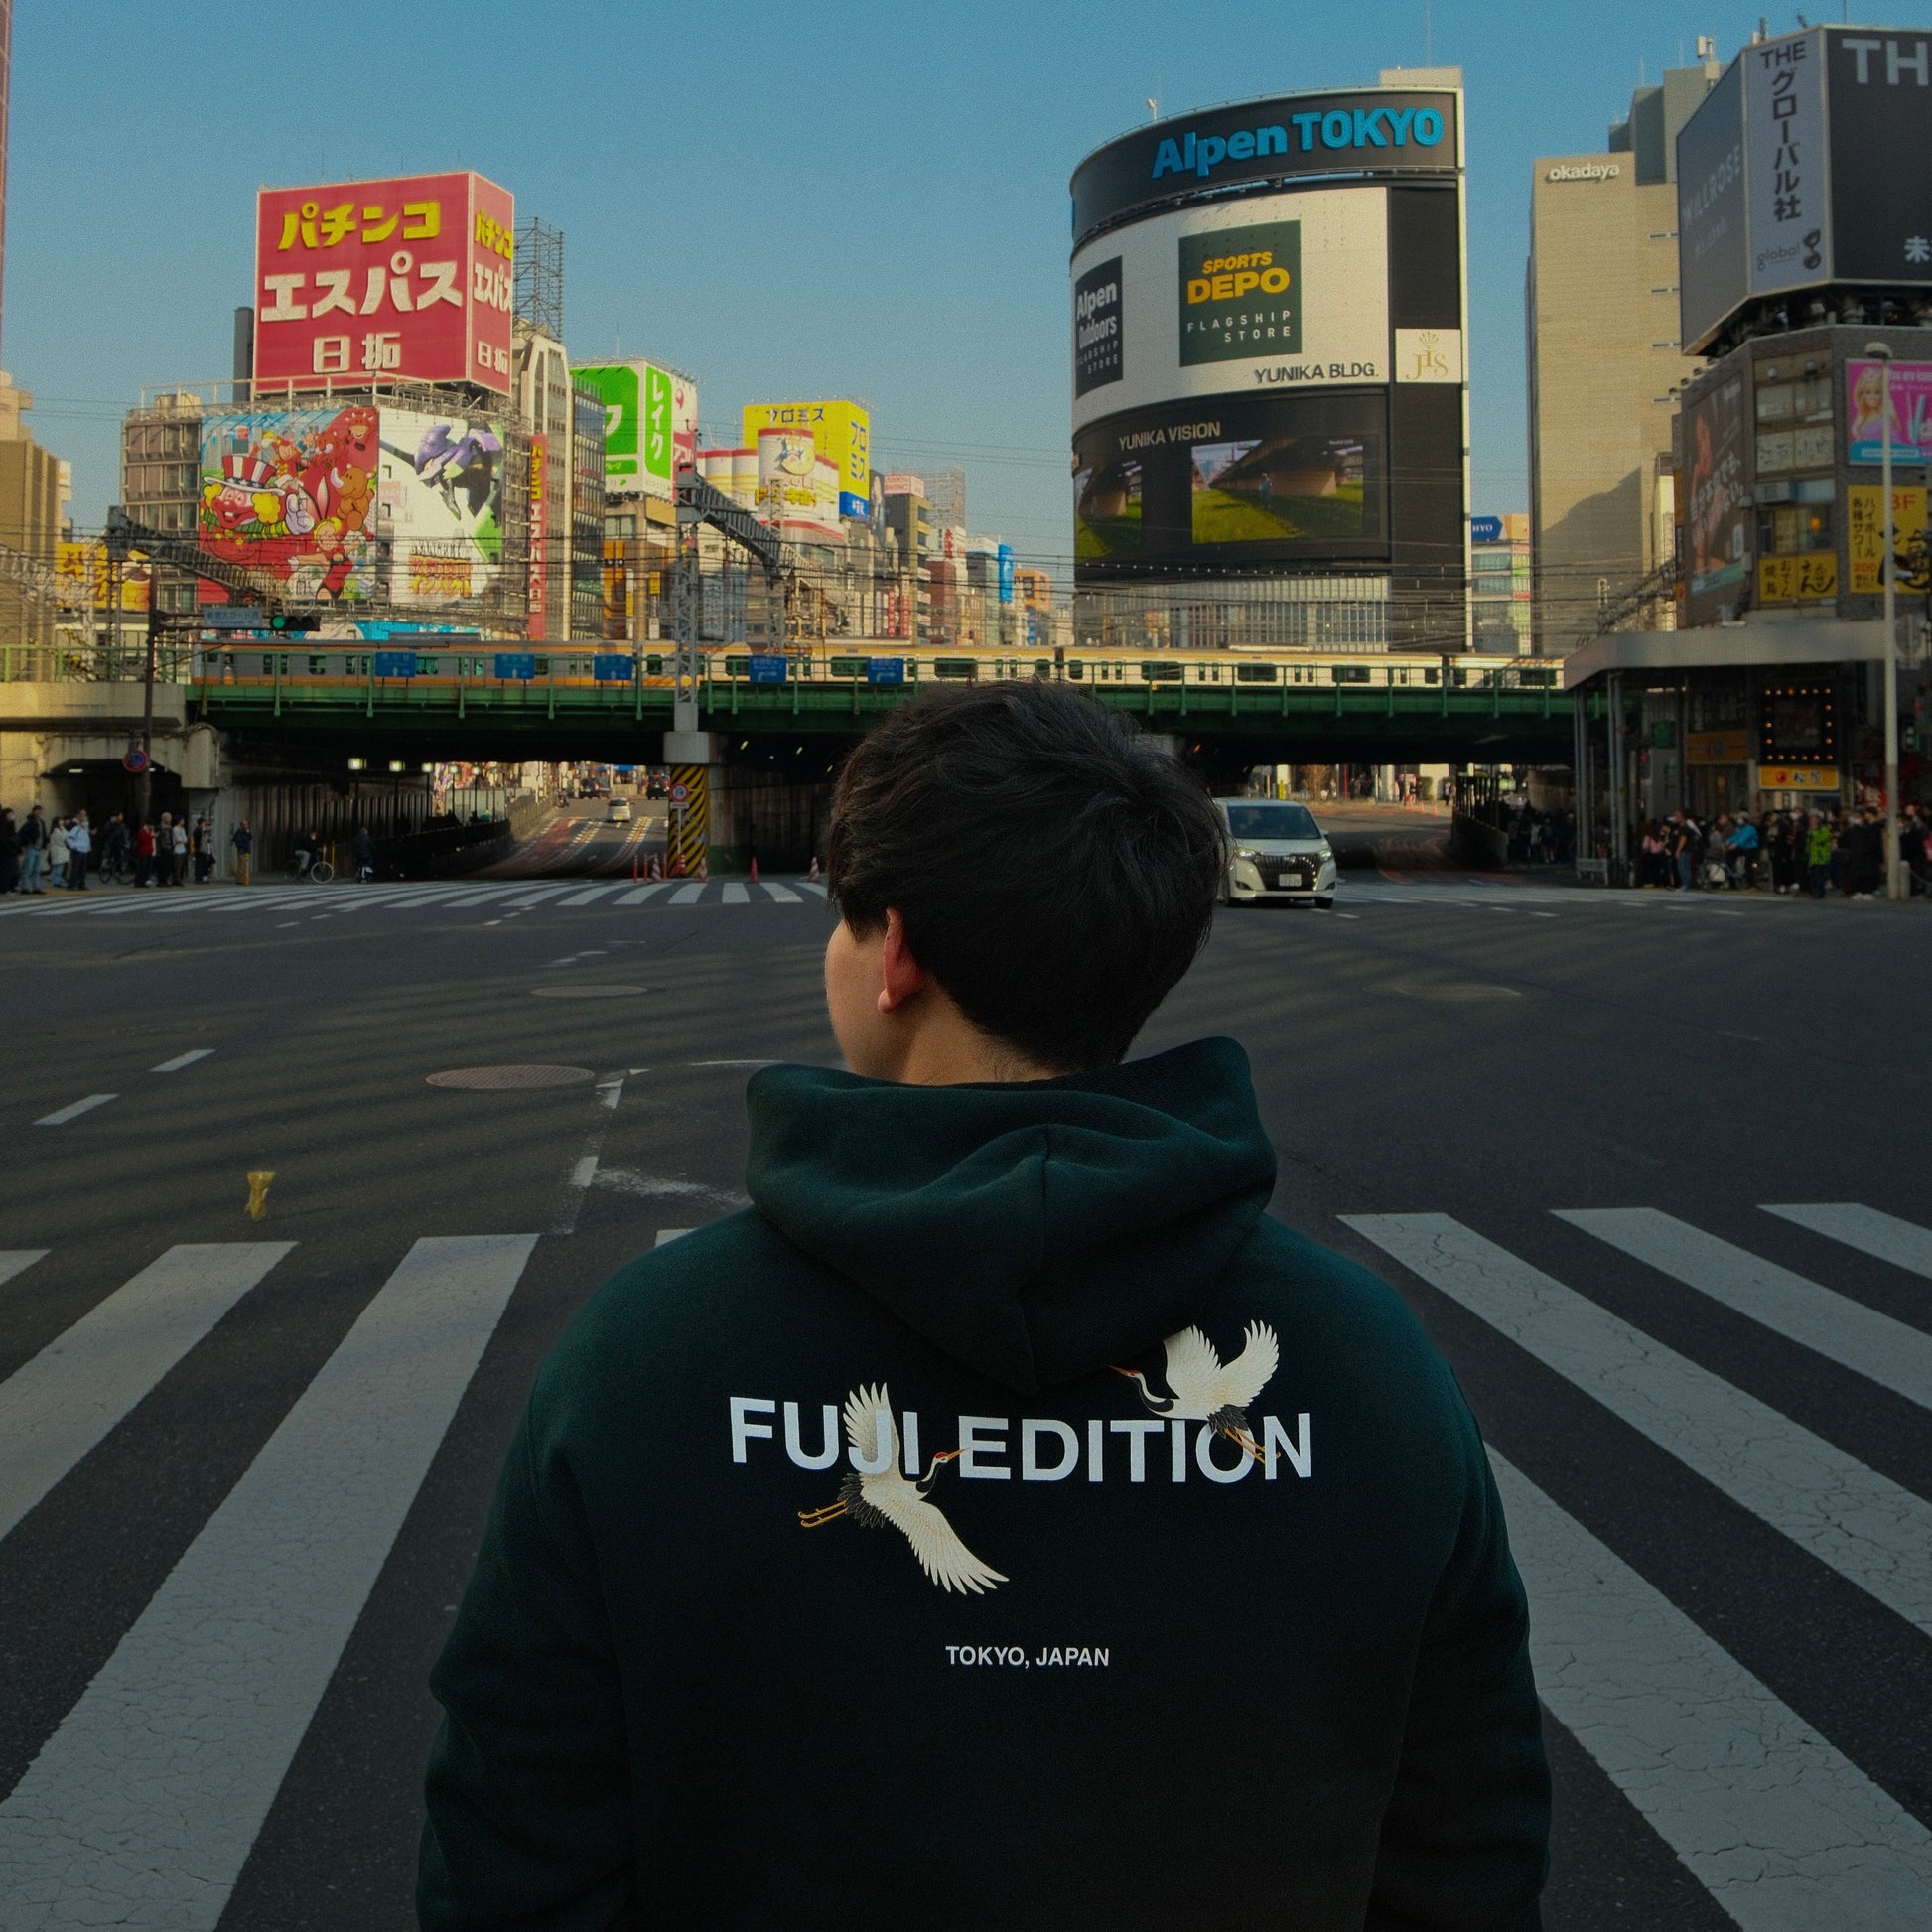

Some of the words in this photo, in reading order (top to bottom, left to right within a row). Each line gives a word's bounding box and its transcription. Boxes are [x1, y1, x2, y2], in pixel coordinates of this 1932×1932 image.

[1760, 41, 1806, 69] THE
[1152, 123, 1288, 180] Alpen
[1292, 107, 1445, 152] TOKYO
[1772, 69, 1803, 222] グローバル社
[1549, 163, 1621, 183] okadaya
[277, 201, 442, 251] パチンコ
[475, 208, 513, 260] パチンコ
[1201, 250, 1274, 275] SPORTS
[1756, 242, 1802, 272] global
[1904, 235, 1932, 262] 未
[260, 250, 464, 323] エスパス
[473, 262, 513, 314] エスパス
[1076, 282, 1118, 320] Alpen
[1187, 267, 1291, 305] DEPO
[1187, 309, 1292, 333] FLAGSHIP
[1224, 325, 1292, 343] STORE
[313, 331, 402, 374] 日拓
[478, 341, 509, 375] 日拓
[1254, 366, 1325, 384] YUNIKA
[1328, 362, 1379, 380] BLDG.
[650, 373, 664, 460] レイク
[1118, 429, 1166, 451] YUNIKA
[1168, 421, 1222, 443] VISION
[1863, 497, 1878, 558] ハイボール
[1779, 559, 1791, 597] おでん
[729, 1396, 920, 1475] FUJI
[958, 1412, 1311, 1484] EDITION
[945, 1645, 1031, 1669] TOKYO,
[1035, 1646, 1110, 1667] JAPAN
